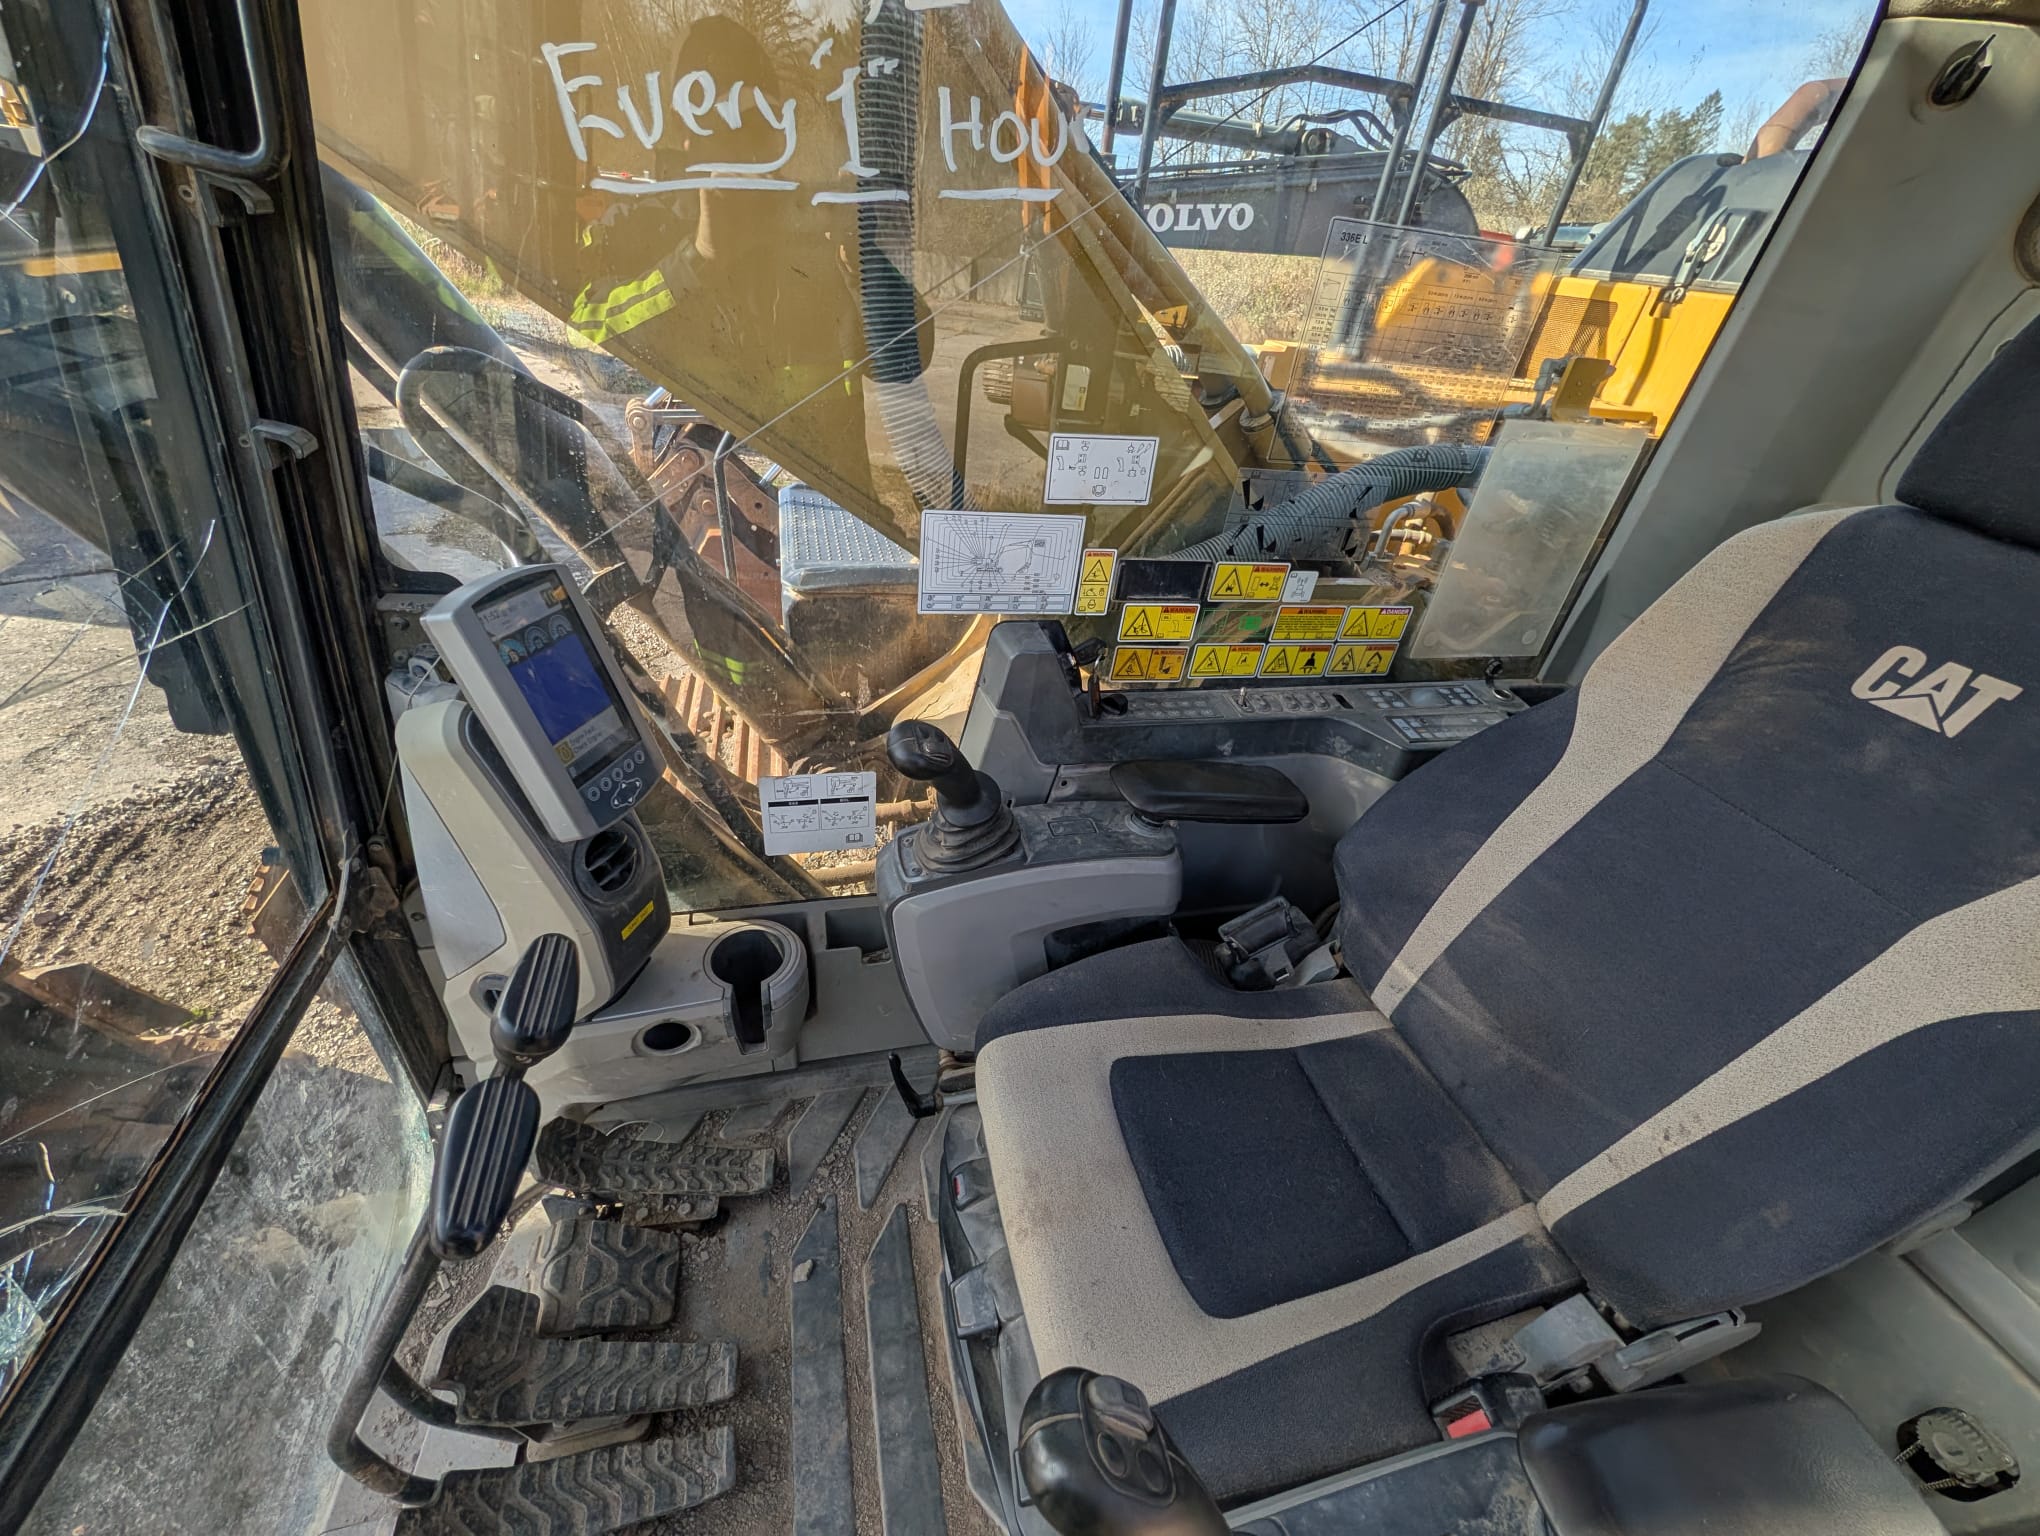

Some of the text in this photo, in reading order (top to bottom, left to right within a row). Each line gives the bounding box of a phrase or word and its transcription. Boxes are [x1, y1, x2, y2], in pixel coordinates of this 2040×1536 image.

[1142, 202, 1255, 233] OLVO
[1340, 231, 1361, 244] 336E
[1851, 645, 2024, 738] CAT
